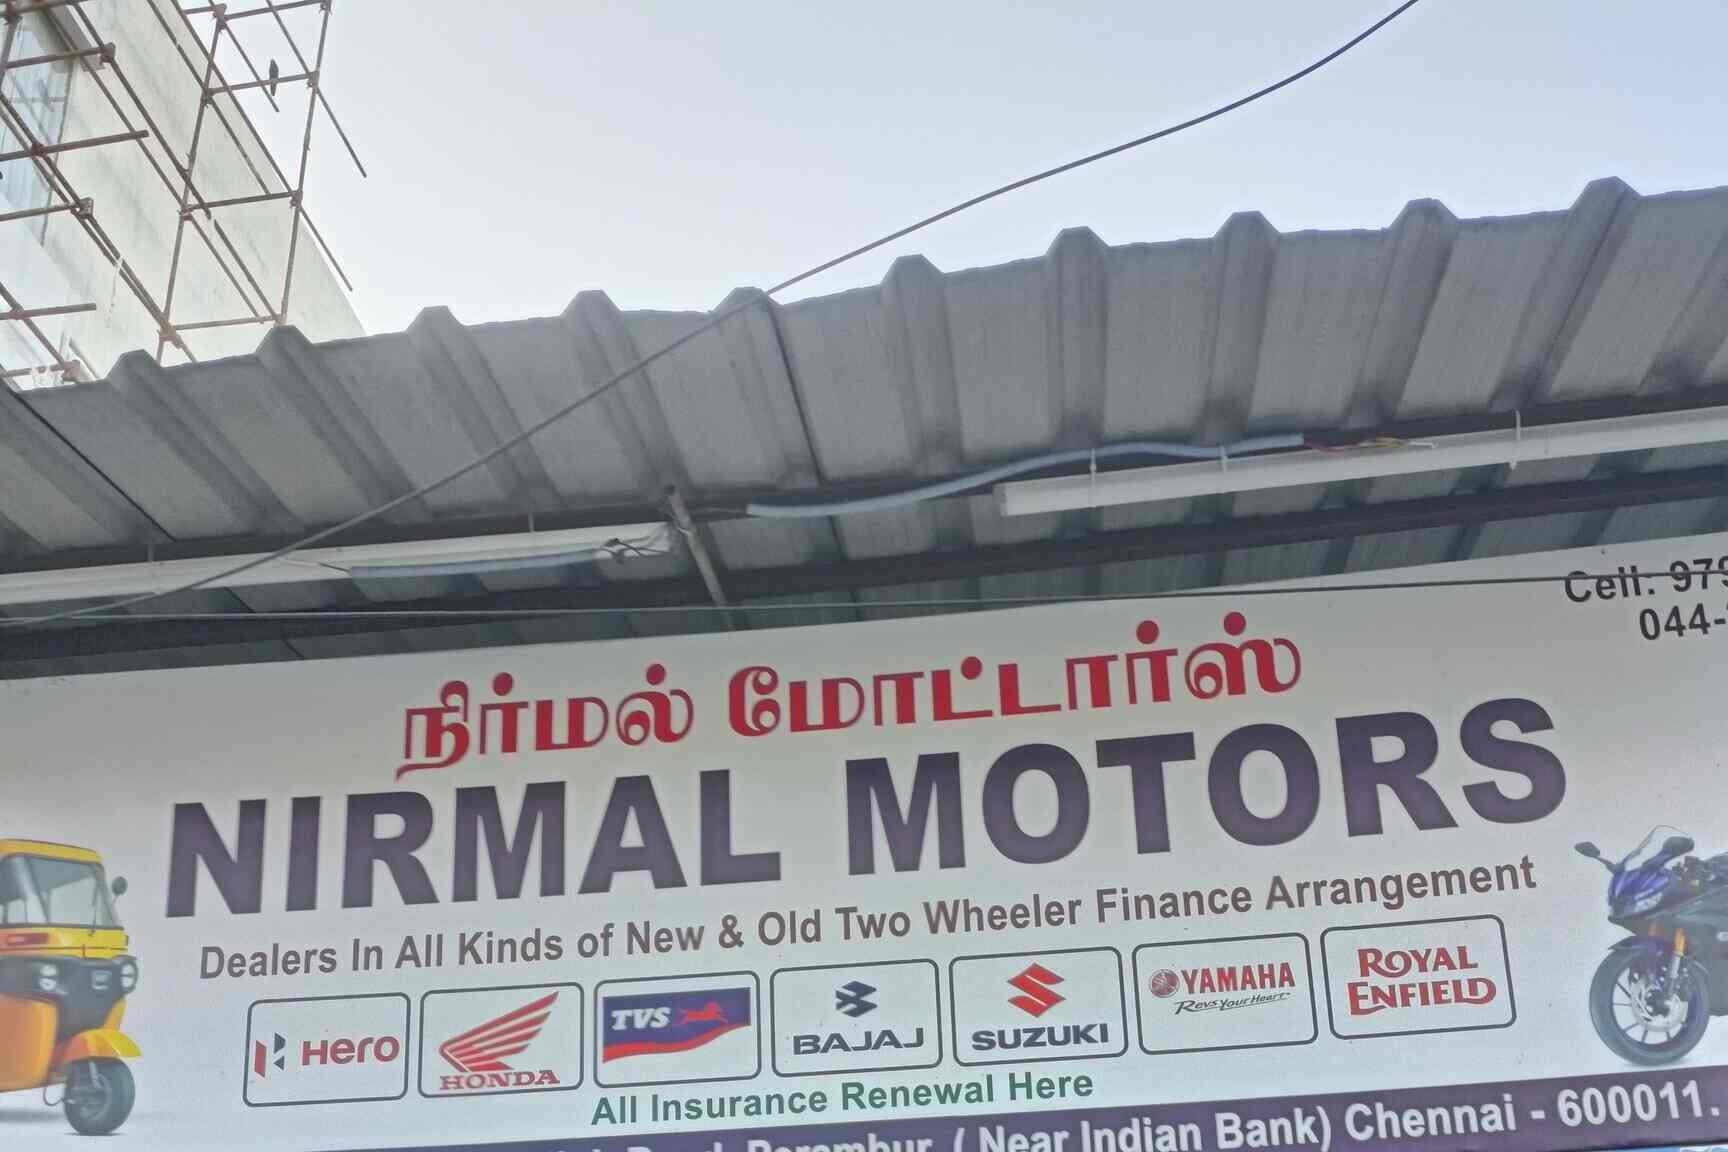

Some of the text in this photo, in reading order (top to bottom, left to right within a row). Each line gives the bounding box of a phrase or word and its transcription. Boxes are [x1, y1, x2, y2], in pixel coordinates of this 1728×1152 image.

[396, 611, 1301, 782] நிர்மல் மோட்டார்ஸ்
[165, 698, 1568, 918] NIRMAL MOTORS
[200, 854, 1537, 980] Dealers In All Kinds of New & Old Two Wheeler Finance Arrangement
[1357, 945, 1479, 978] ROYAL
[1181, 962, 1296, 995] YAMAHA
[1174, 993, 1291, 1015] Revs Your Heart
[1347, 977, 1497, 1015] ENFIELD
[611, 1006, 671, 1031] TVS
[301, 1035, 400, 1067] Hero
[792, 1027, 925, 1056] BAJAJ
[971, 1023, 1109, 1051] SUZUKI
[439, 1069, 561, 1091] HONDA
[591, 1071, 1094, 1126] All Insurance Renewal Here
[1215, 1107, 1332, 1152] Bank)
[1344, 1093, 1517, 1141] Chennai
[1556, 1077, 1722, 1127] 600011.
